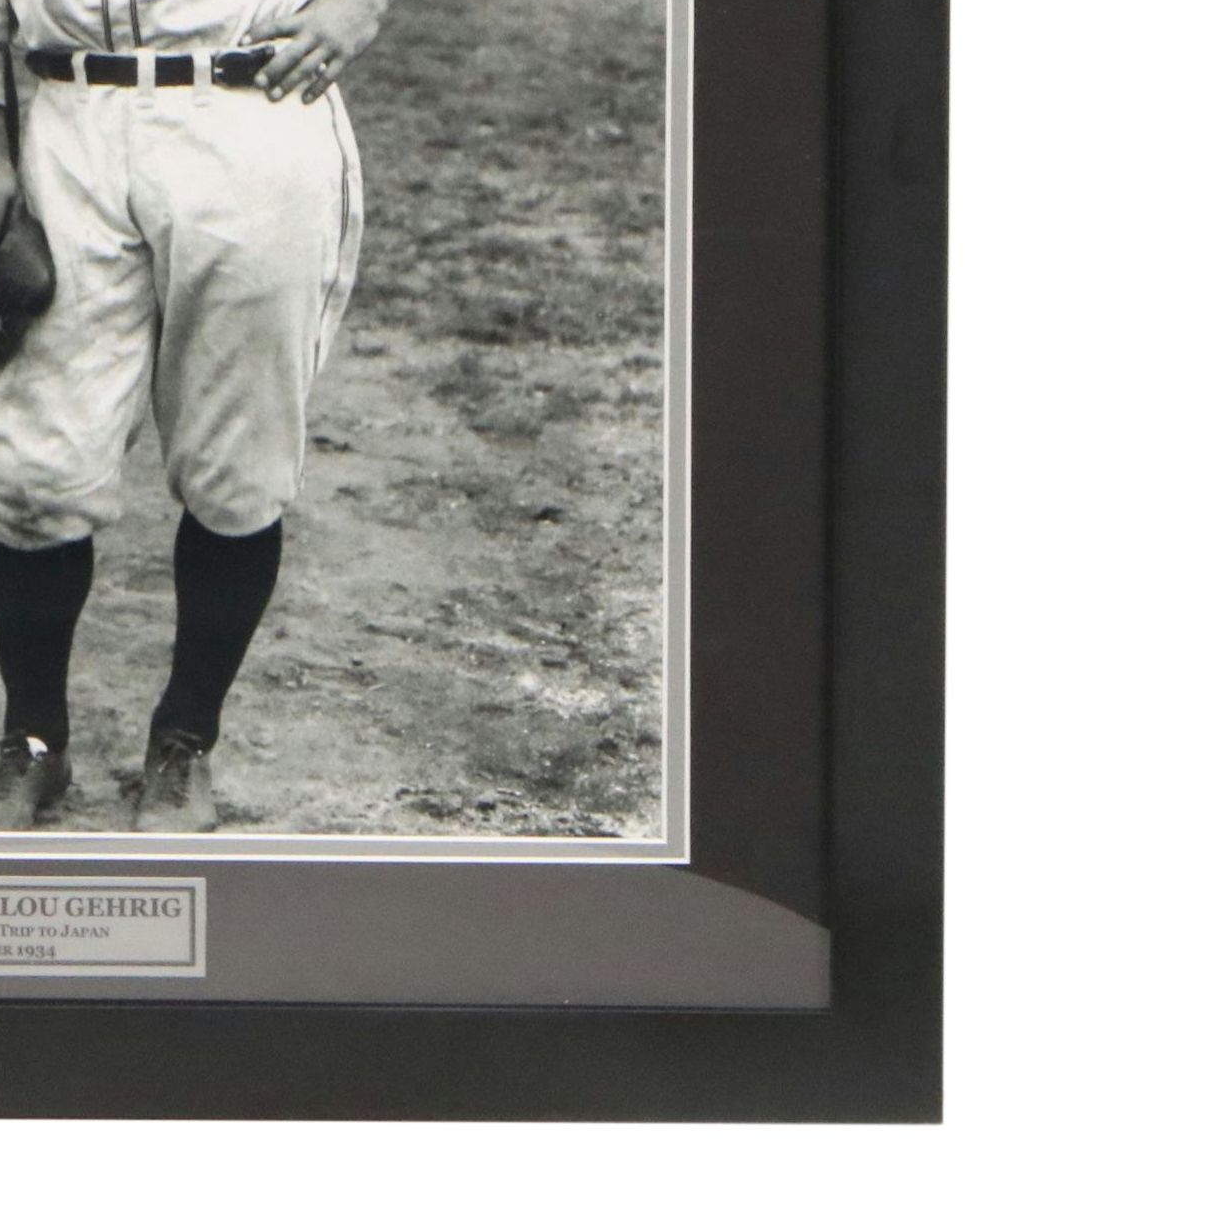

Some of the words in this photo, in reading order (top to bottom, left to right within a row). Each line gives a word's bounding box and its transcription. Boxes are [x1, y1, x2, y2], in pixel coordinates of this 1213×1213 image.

[0, 896, 58, 917] LOU
[65, 897, 183, 918] GEHRIG
[17, 943, 57, 957] 1934
